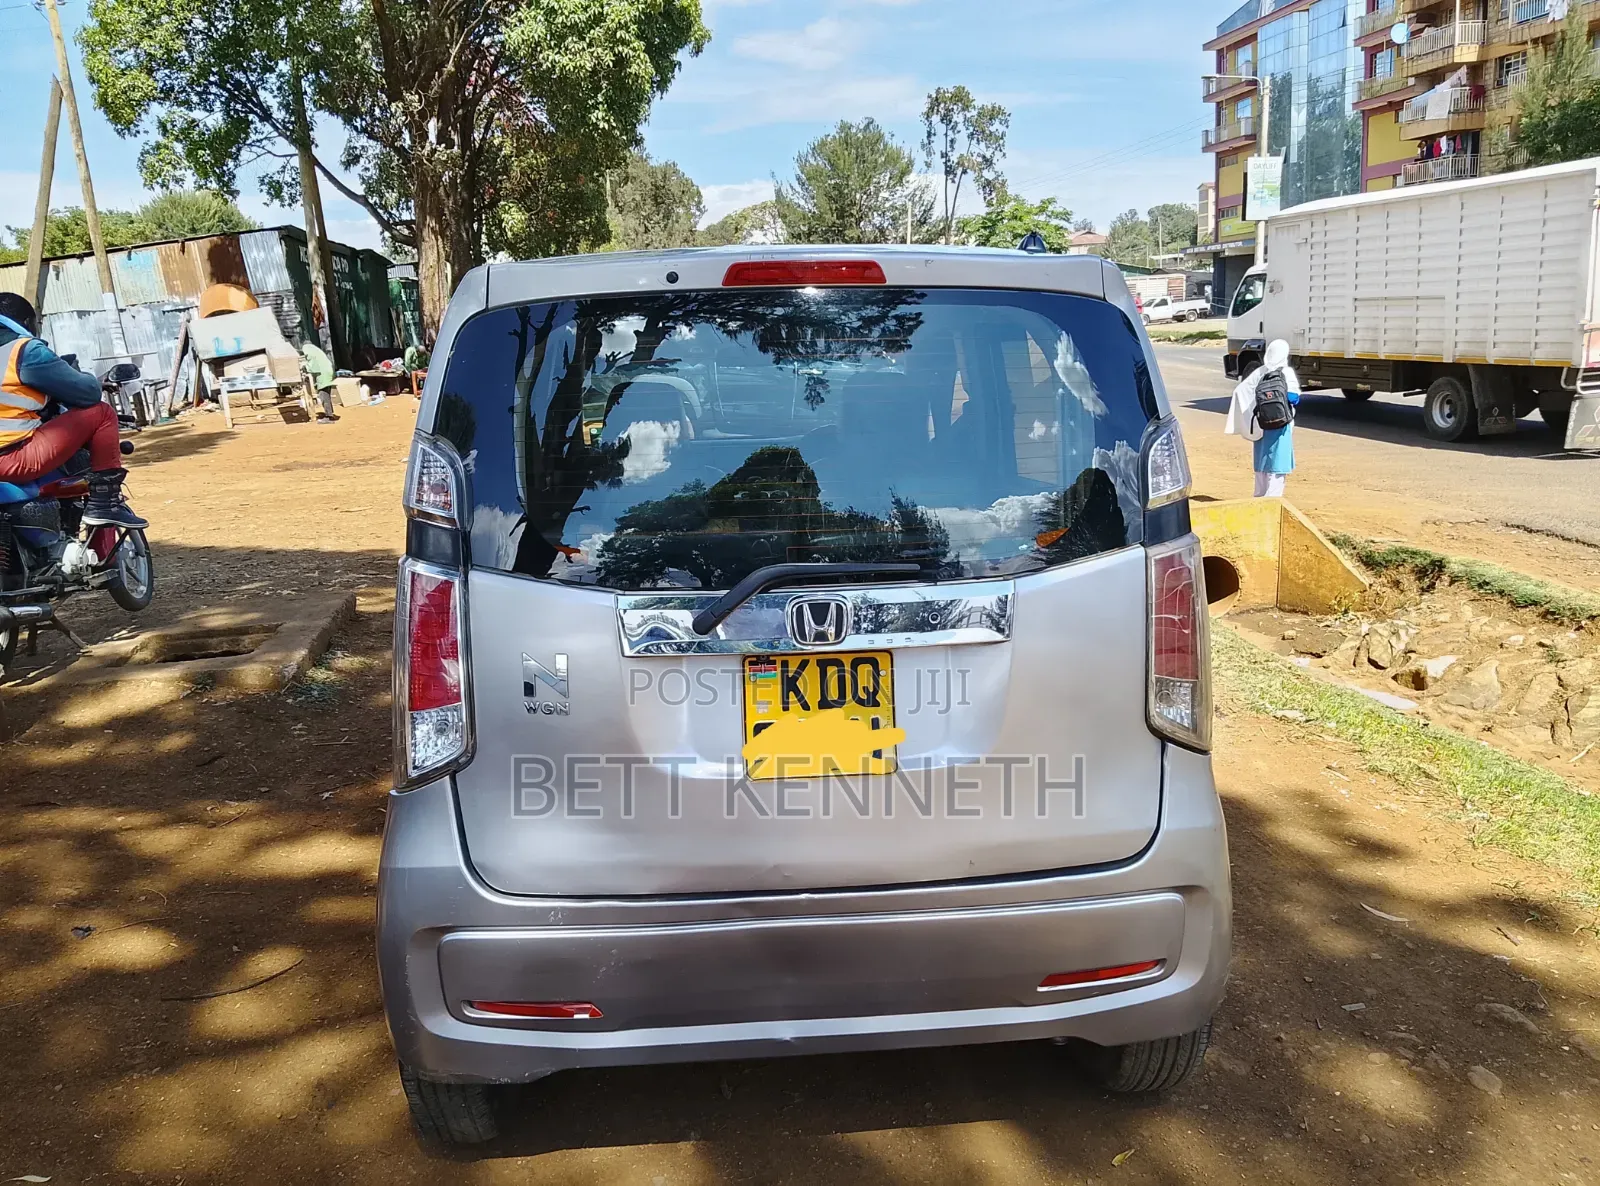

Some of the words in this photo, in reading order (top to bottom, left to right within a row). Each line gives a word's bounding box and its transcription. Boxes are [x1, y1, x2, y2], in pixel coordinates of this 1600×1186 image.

[522, 652, 570, 699] N
[781, 657, 881, 712] KDQ
[523, 701, 570, 716] WGN
